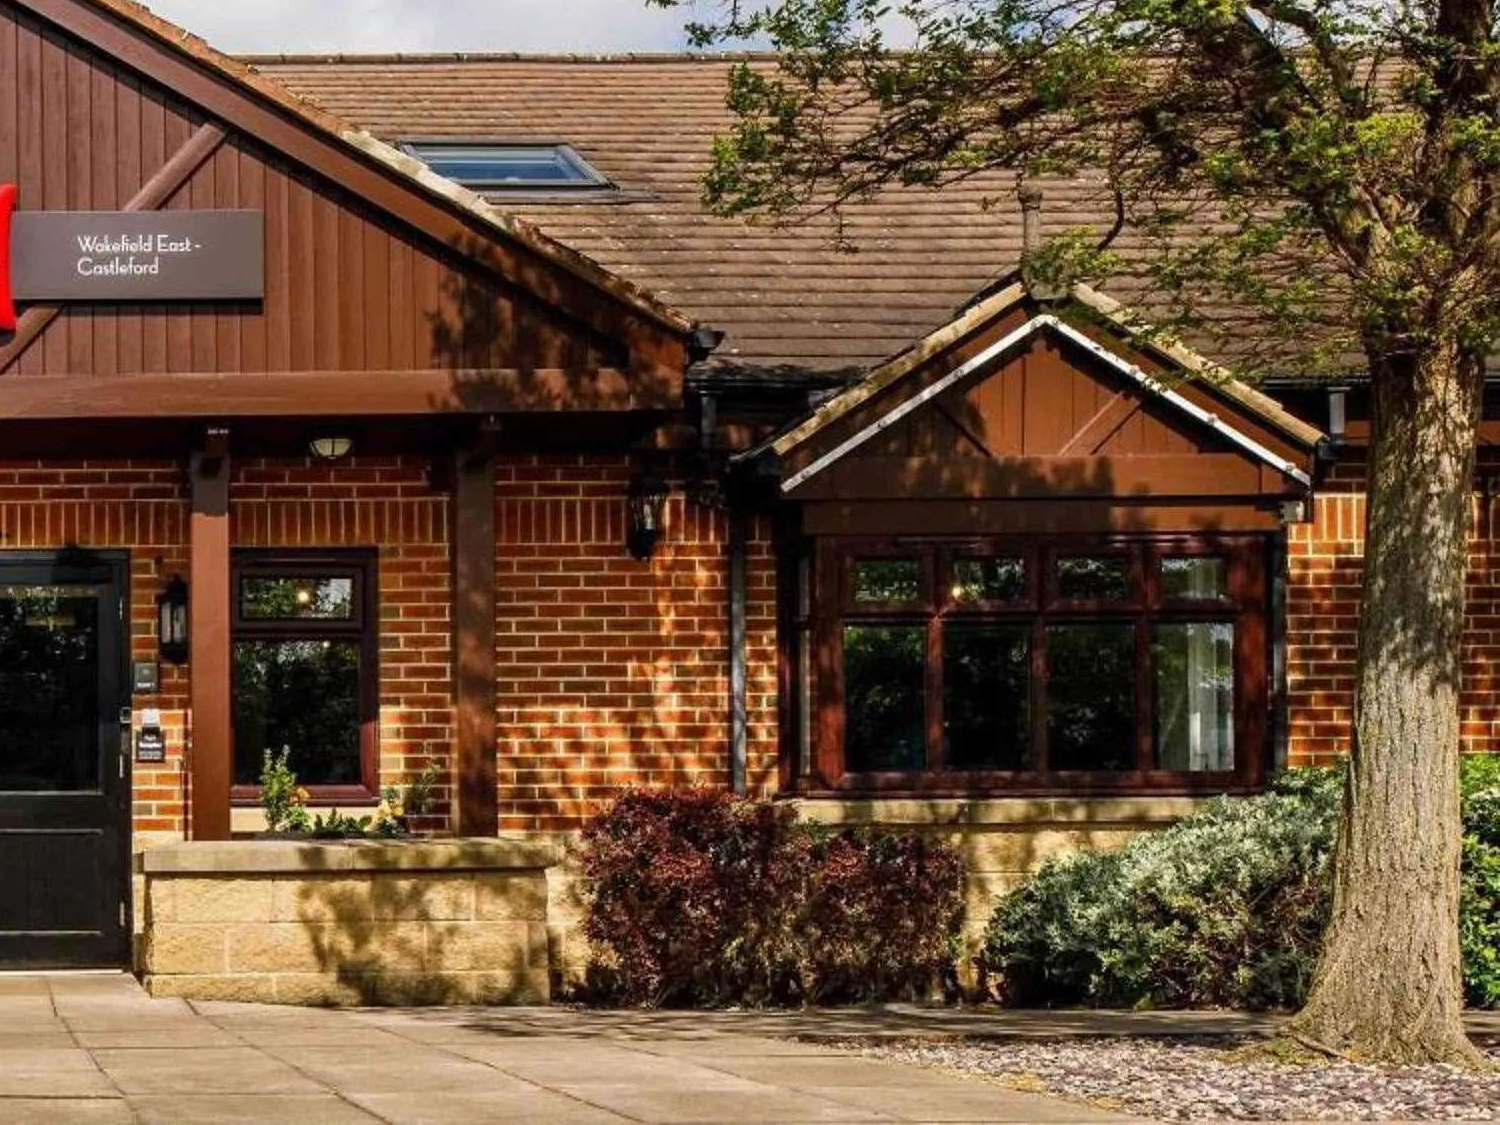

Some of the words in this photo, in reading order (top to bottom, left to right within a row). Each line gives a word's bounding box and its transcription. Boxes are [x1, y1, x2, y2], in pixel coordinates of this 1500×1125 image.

[77, 234, 153, 252] Wakefield
[157, 234, 191, 252] East
[77, 256, 159, 275] Castleford
